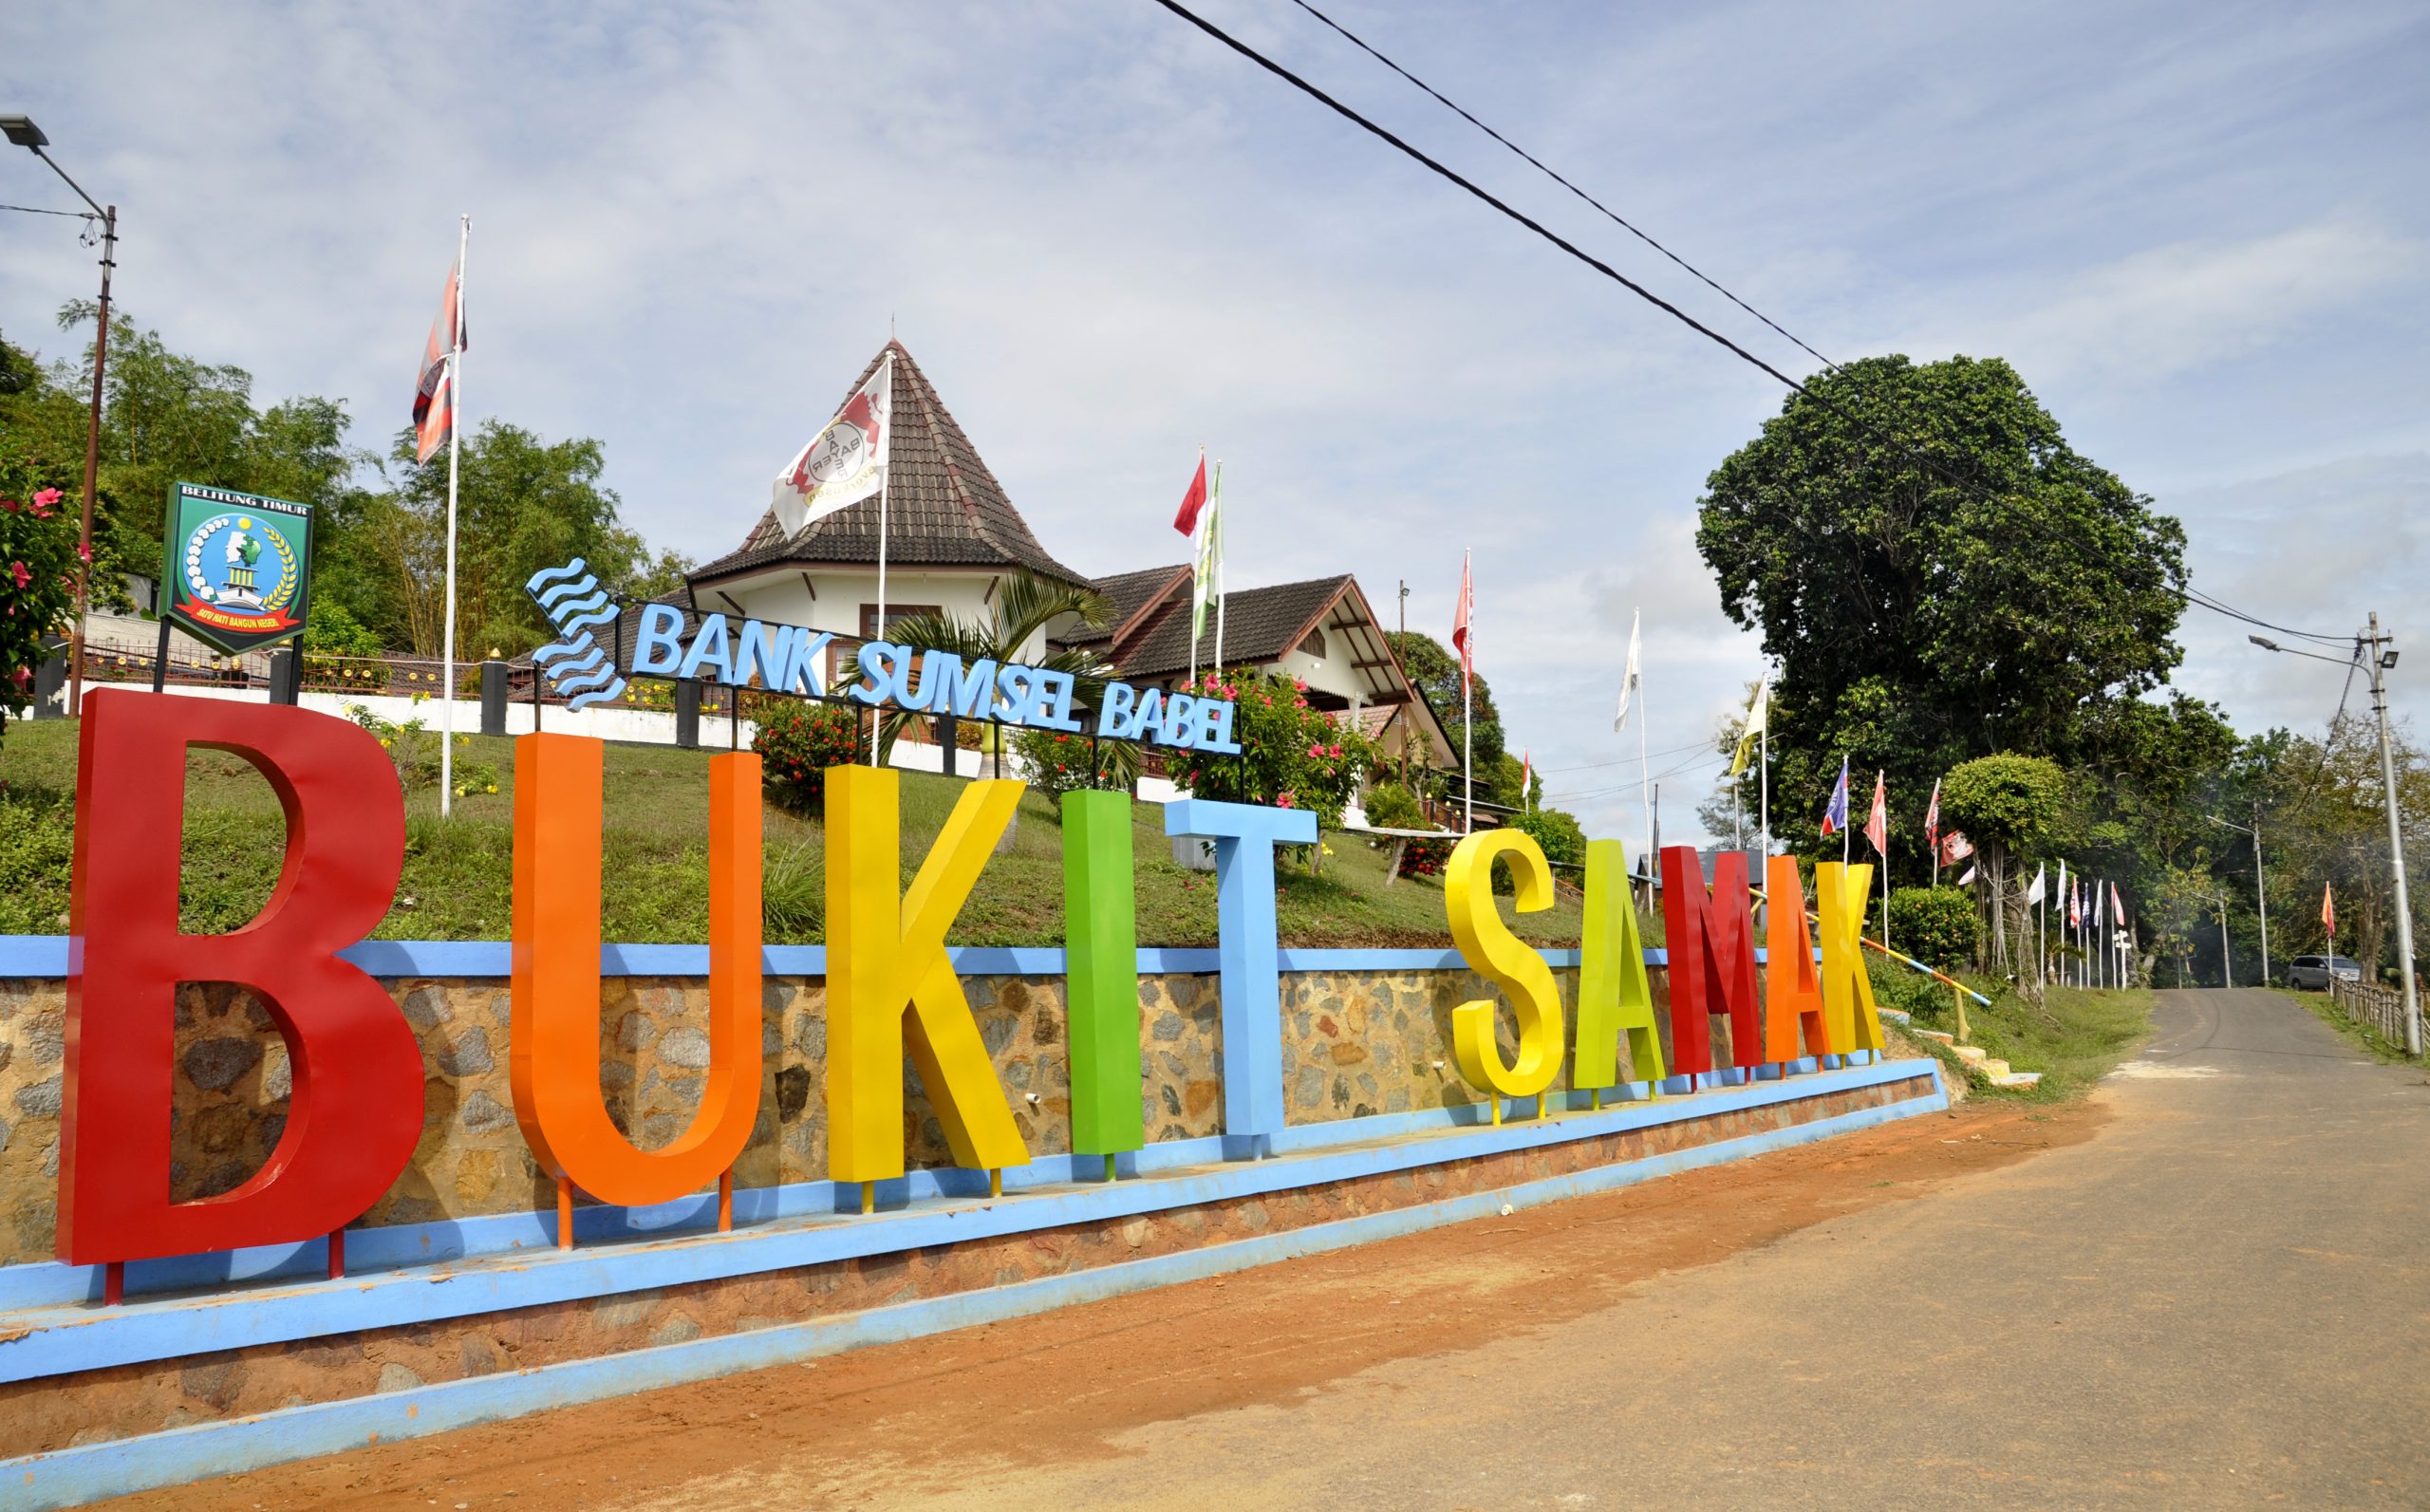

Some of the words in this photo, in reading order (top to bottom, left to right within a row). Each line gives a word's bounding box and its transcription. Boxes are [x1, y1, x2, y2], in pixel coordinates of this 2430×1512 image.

[181, 485, 256, 507] BELITUNG
[261, 498, 308, 515] TIMUR
[212, 613, 229, 625] HATI
[229, 616, 257, 628] BANGUN
[631, 603, 834, 698] BANK
[849, 640, 1080, 733] SUMSEL
[1098, 681, 1242, 755] BABEL
[56, 687, 1318, 1265] BUKIT
[1445, 828, 1885, 1096] SAMAK
